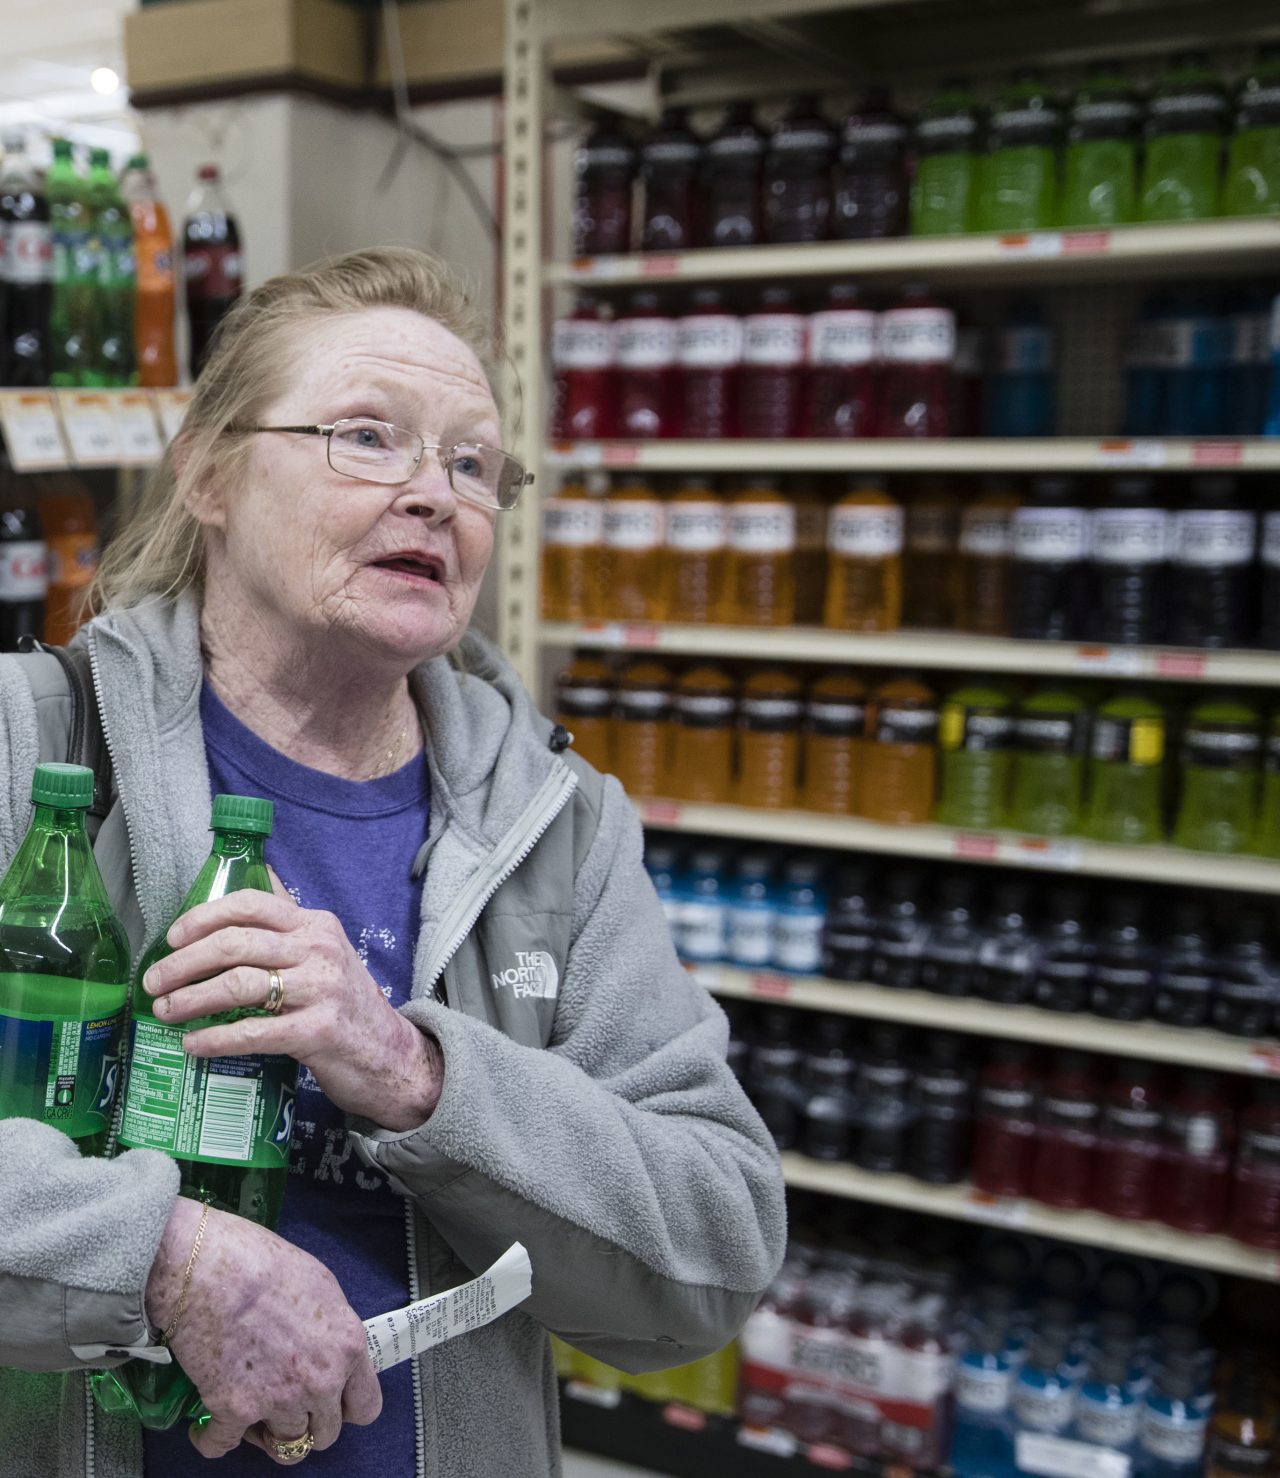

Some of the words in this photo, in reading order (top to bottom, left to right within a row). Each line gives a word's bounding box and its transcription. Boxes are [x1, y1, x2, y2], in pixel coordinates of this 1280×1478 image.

[515, 951, 542, 967] THE
[46, 1080, 55, 1098] REFILL
[45, 1098, 54, 1107] NO
[242, 1120, 251, 1145] 49000
